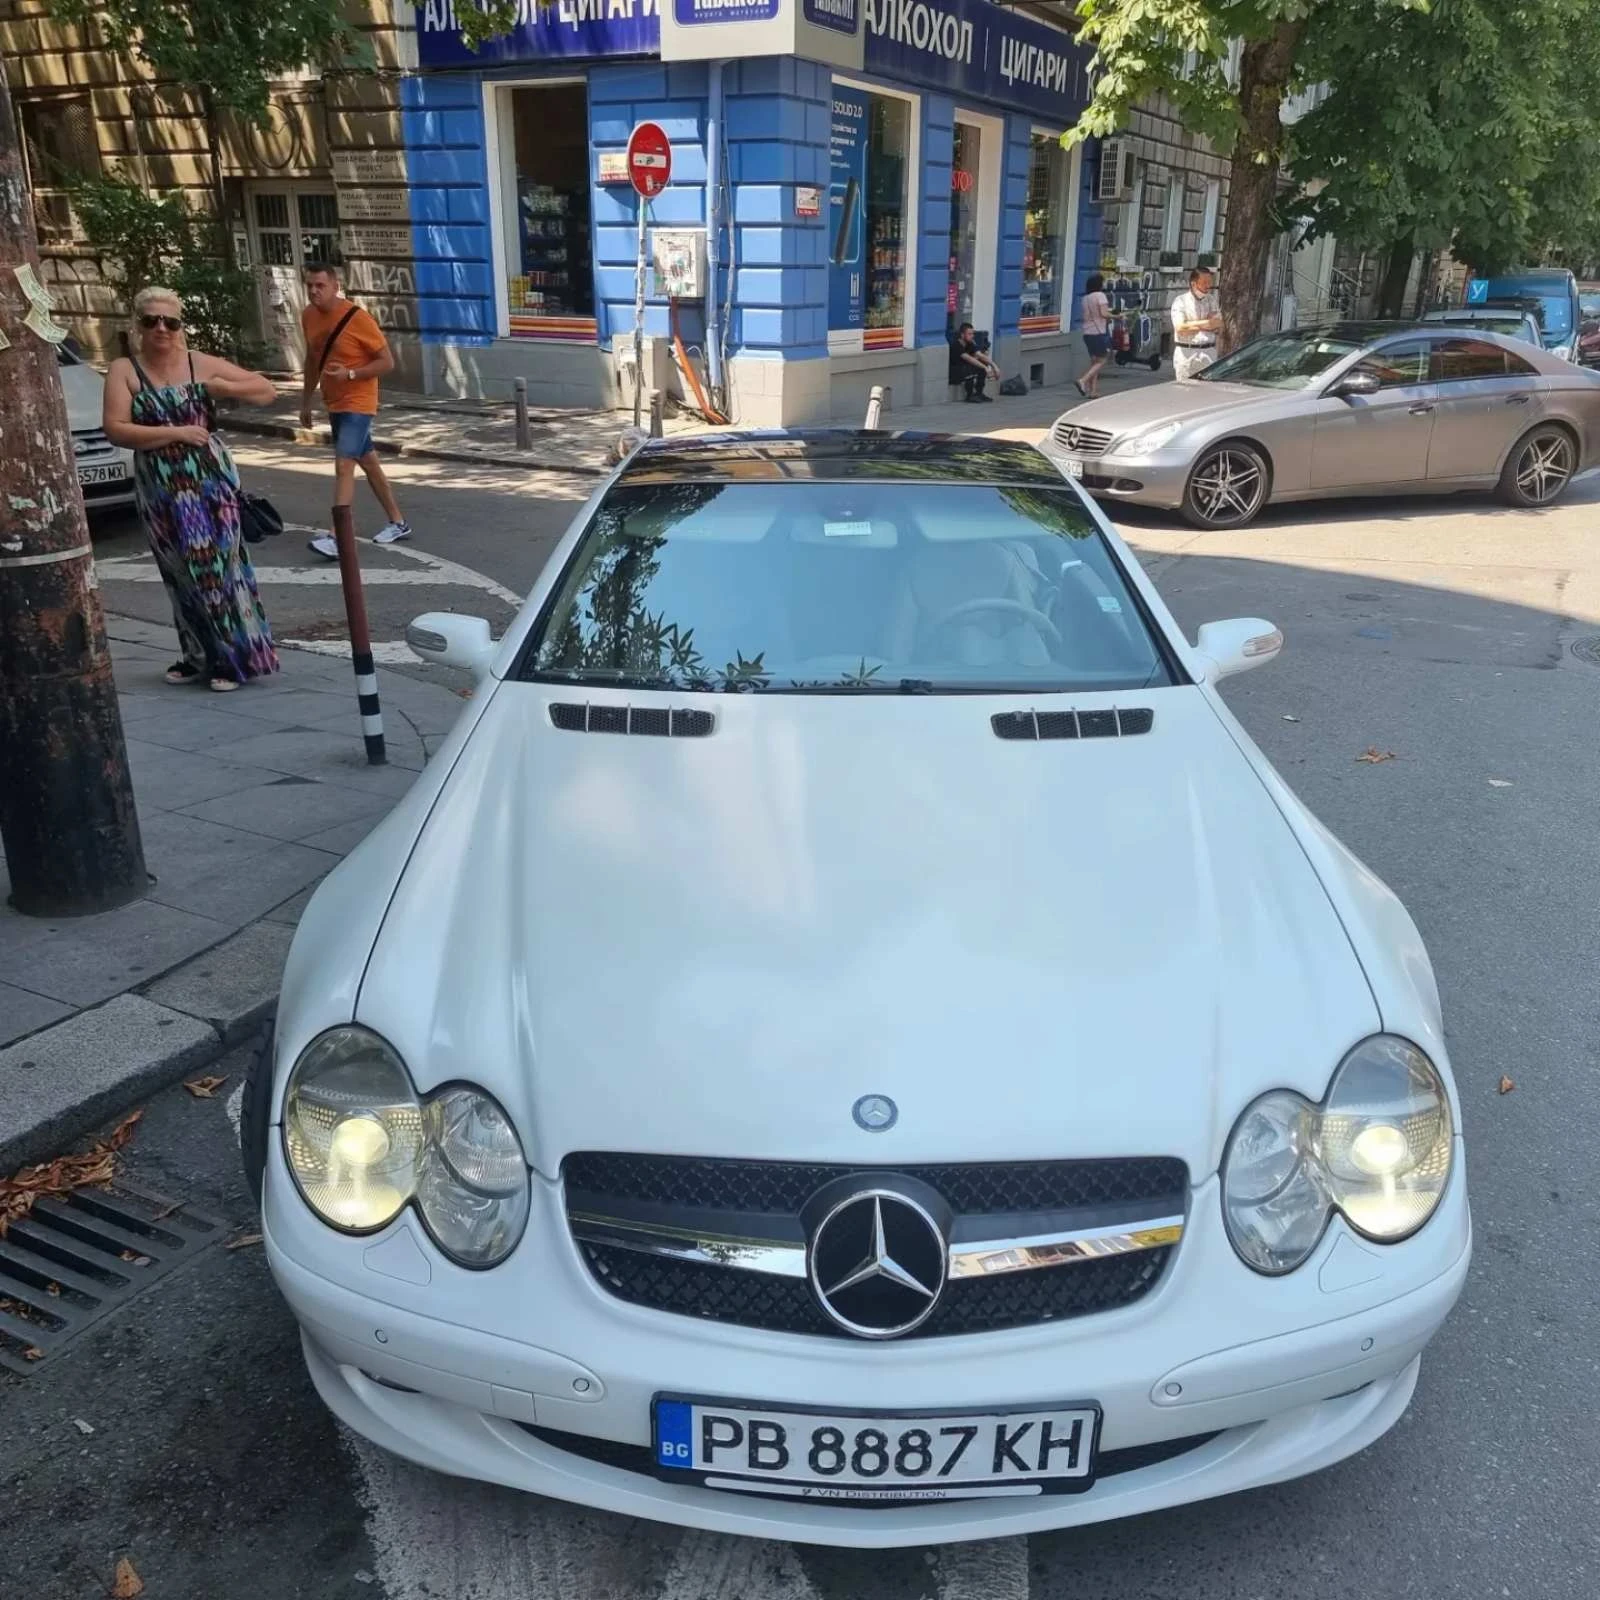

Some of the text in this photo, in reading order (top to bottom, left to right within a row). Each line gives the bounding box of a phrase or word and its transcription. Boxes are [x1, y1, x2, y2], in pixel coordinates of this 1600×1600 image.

[864, 0, 974, 64] АЛКОХОЛ
[1000, 35, 1067, 93] ЦИГАРИ
[108, 466, 123, 480] MX
[662, 1441, 689, 1459] BG
[702, 1409, 1084, 1477] PB 8887 KH
[846, 1490, 946, 1499] DISTRIBUTION
